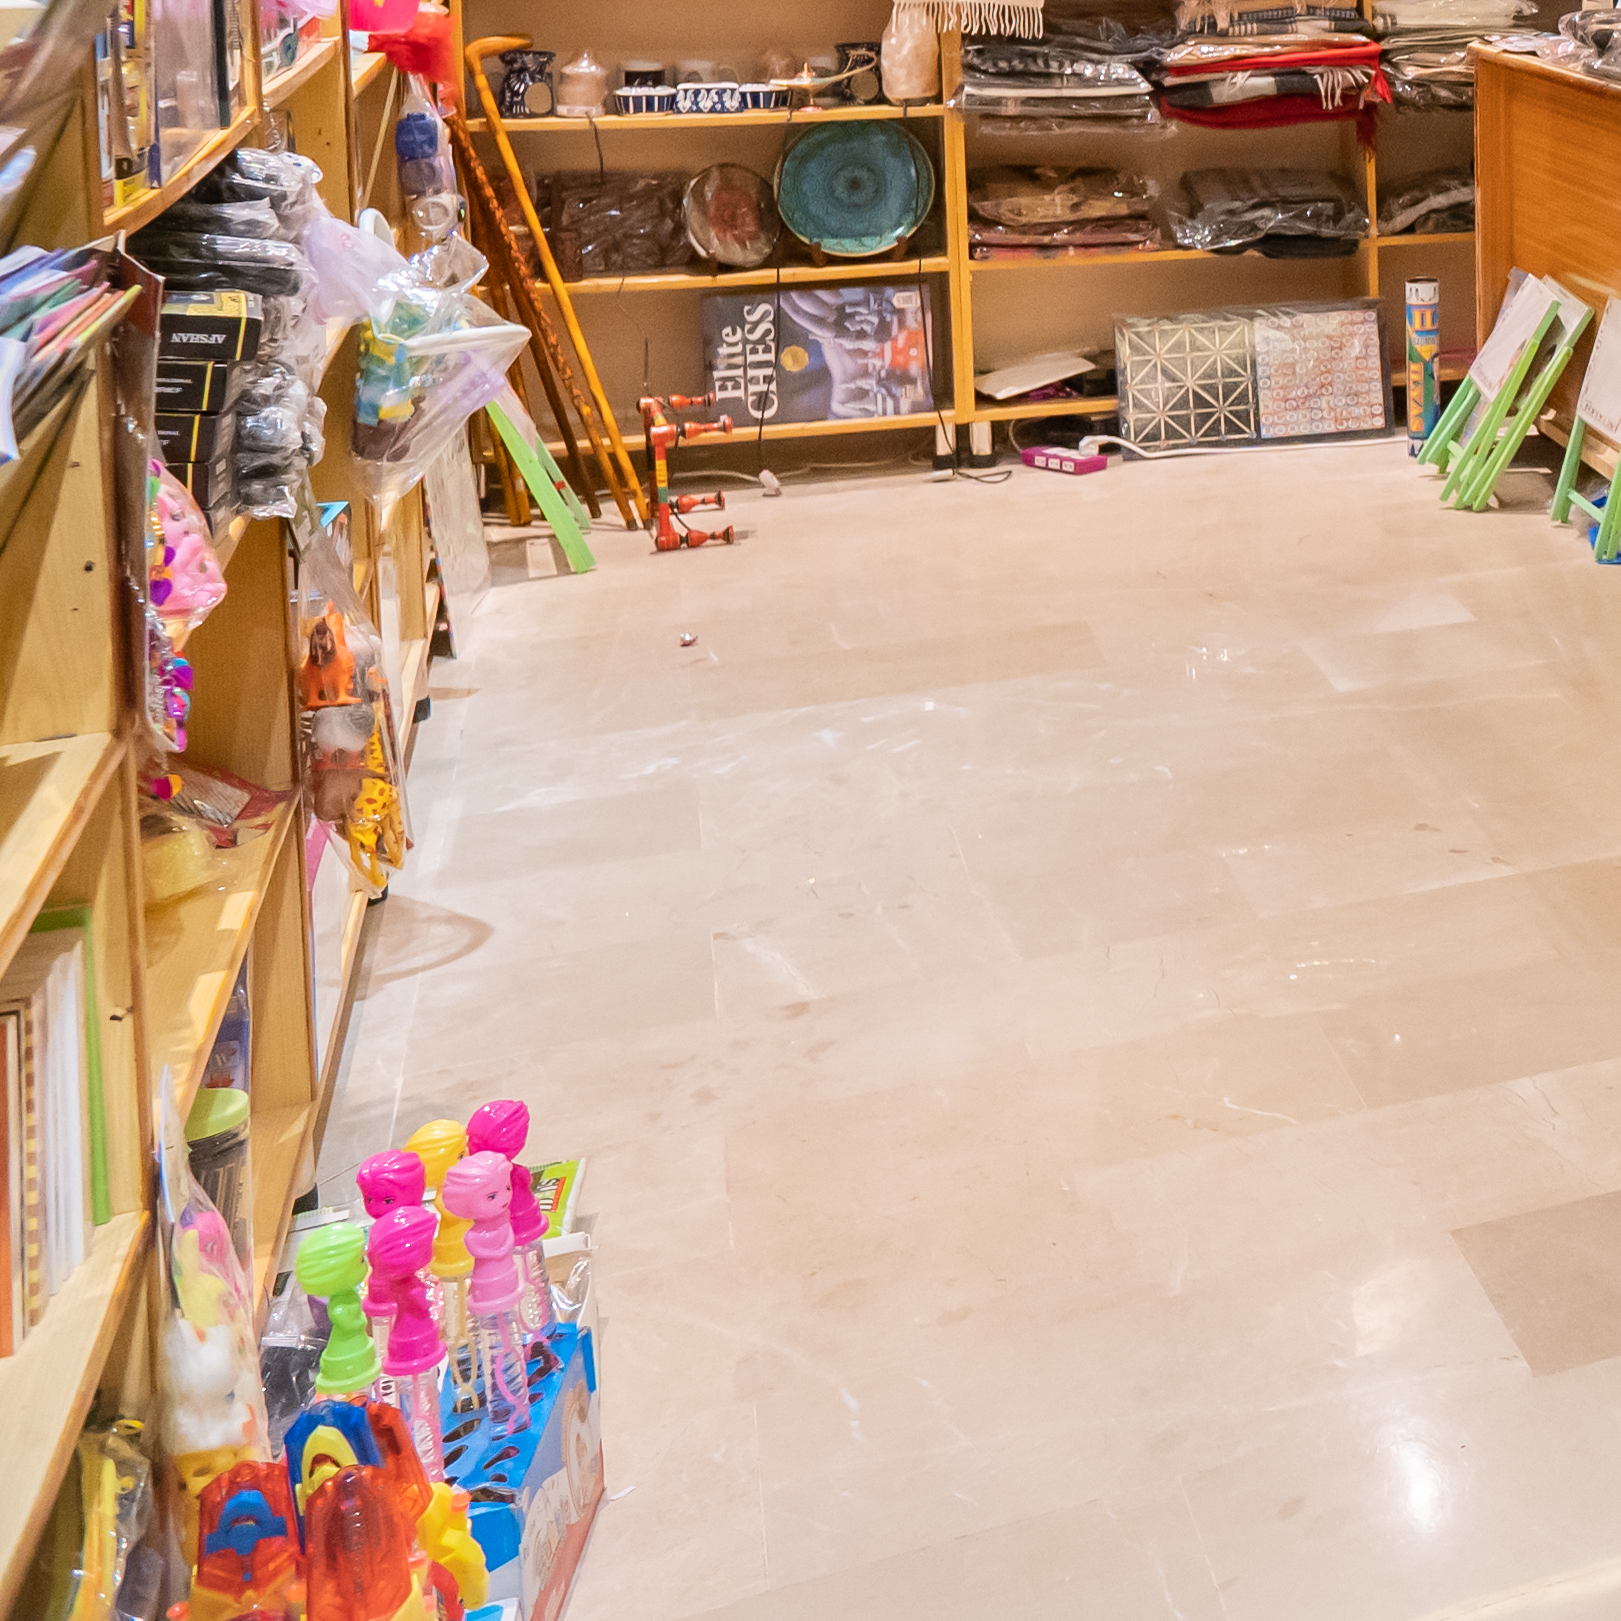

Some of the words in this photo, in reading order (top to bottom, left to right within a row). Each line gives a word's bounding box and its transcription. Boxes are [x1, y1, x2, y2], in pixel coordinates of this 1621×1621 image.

[168, 332, 227, 345] AFSHAN
[712, 325, 745, 402] Elite
[743, 302, 779, 420] CHESS
